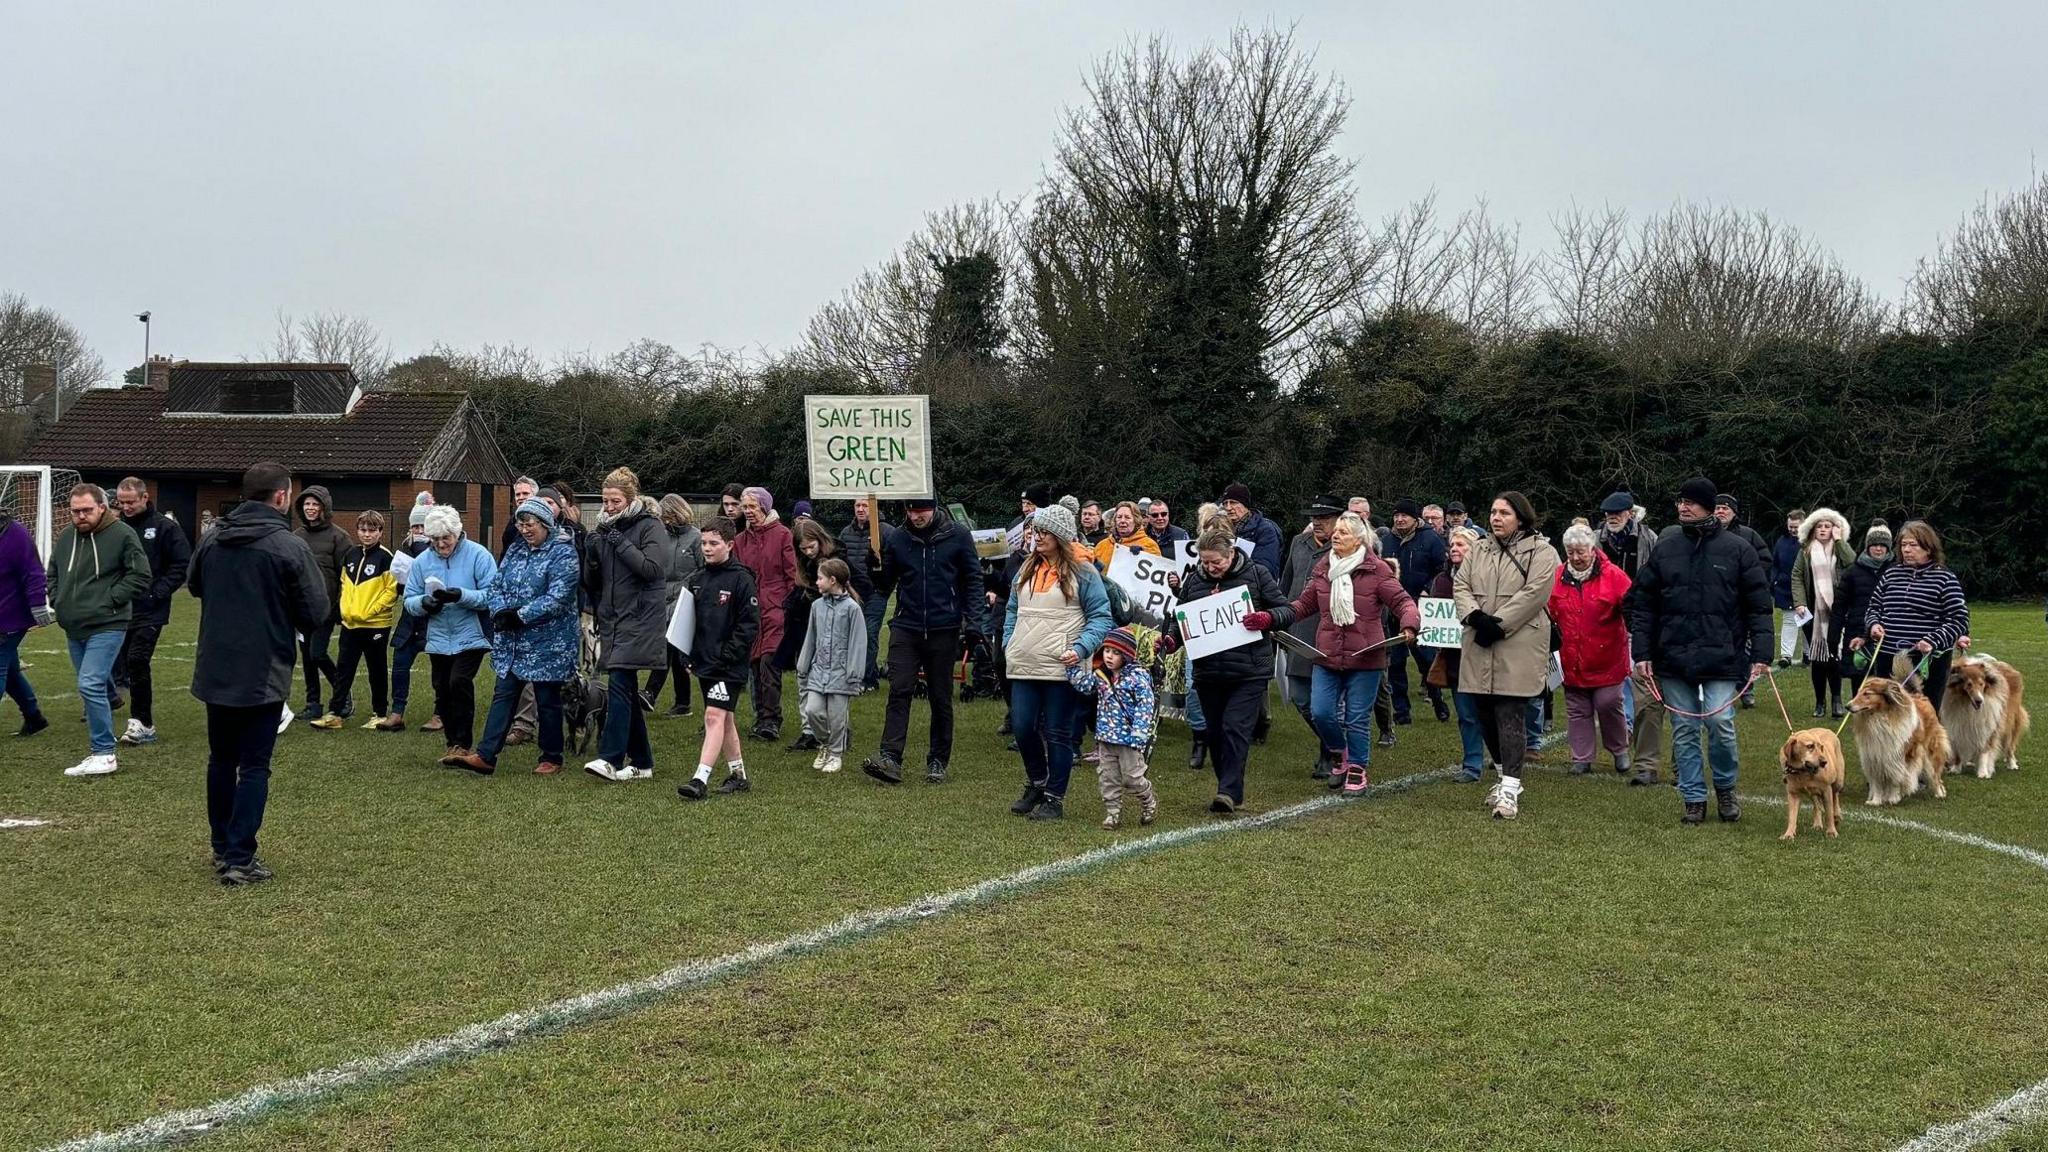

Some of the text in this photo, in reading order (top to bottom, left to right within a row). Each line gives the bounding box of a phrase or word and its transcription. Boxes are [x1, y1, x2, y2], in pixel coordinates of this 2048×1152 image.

[817, 408, 912, 428] SAVE THIS
[827, 435, 906, 461] GREEN
[829, 468, 894, 487] SPACE
[1134, 559, 1166, 586] Sa
[1185, 600, 1245, 639] LEAVE
[1424, 601, 1457, 619] SAV
